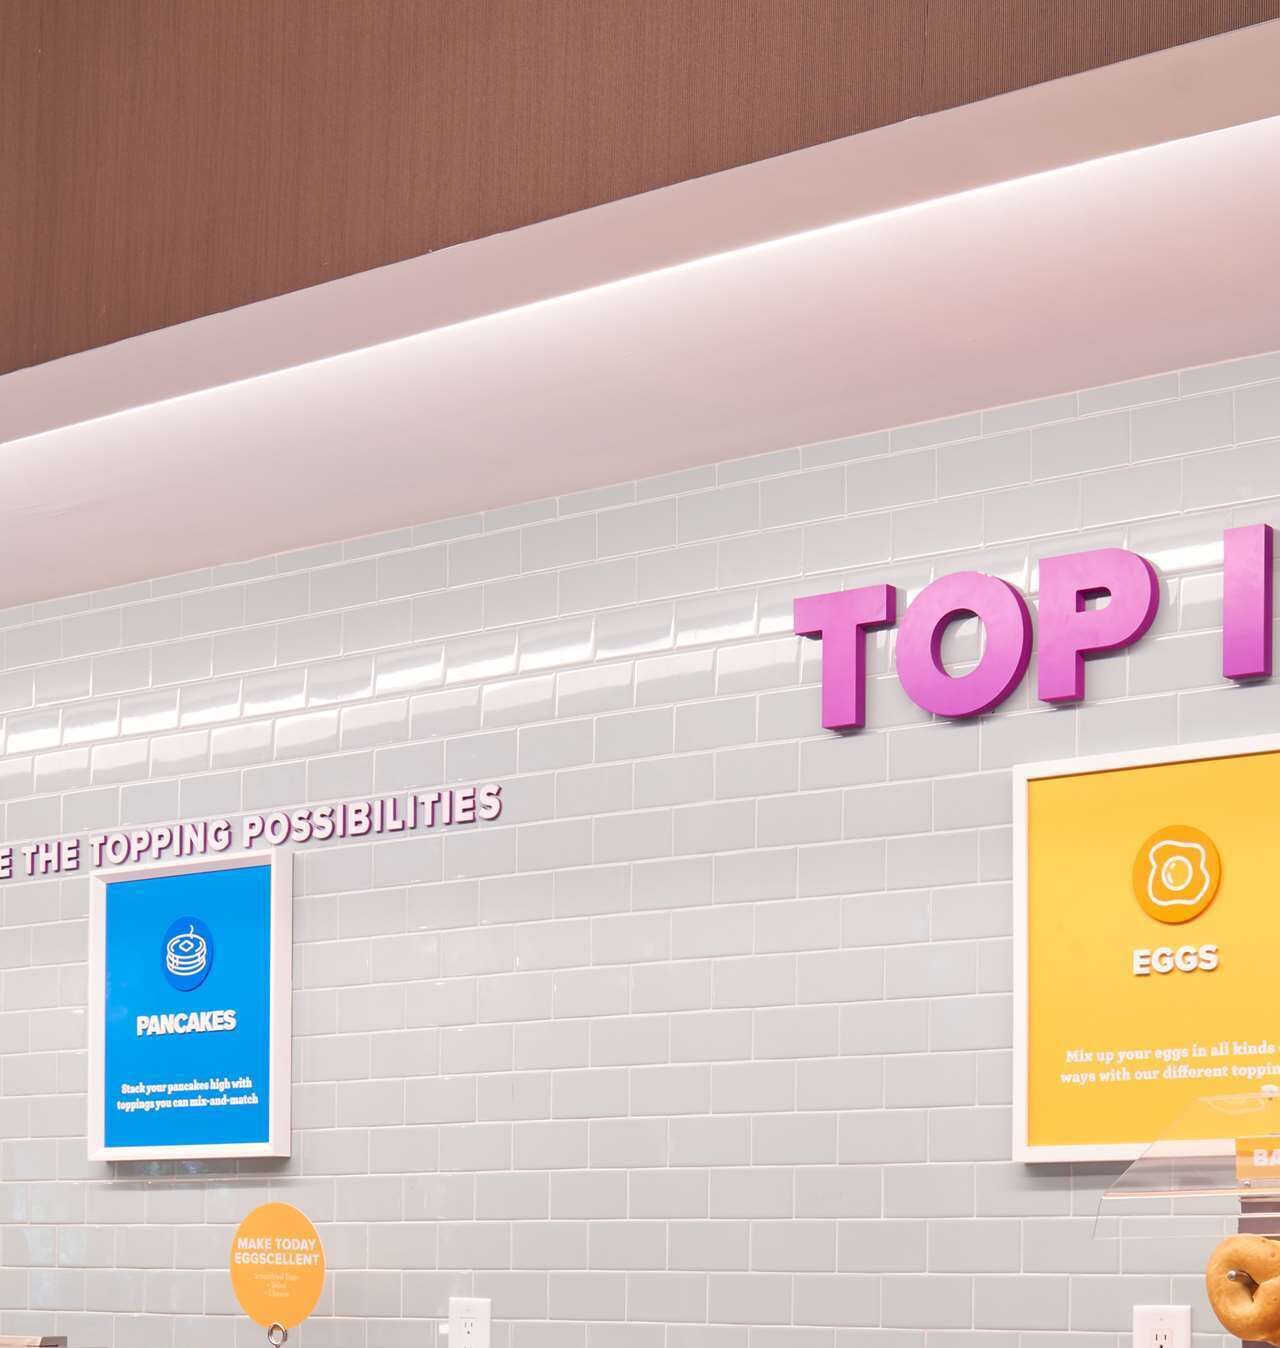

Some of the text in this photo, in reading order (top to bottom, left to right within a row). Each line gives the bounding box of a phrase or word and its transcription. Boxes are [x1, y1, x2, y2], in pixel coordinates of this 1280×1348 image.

[794, 547, 1160, 731] TOP
[21, 839, 80, 876] THE
[89, 818, 232, 867] TOPPING
[242, 784, 503, 848] POSSIBILITIES
[1131, 944, 1219, 977] EGGS
[136, 1009, 238, 1037] PANCAKES
[1065, 1050, 1094, 1063] Mix
[1096, 1051, 1114, 1064] up
[1117, 1049, 1151, 1063] your
[1154, 1047, 1189, 1061] eggs
[1192, 1043, 1207, 1058] in
[1210, 1041, 1229, 1056] all
[1233, 1040, 1275, 1055] kinds
[146, 1083, 166, 1096] your
[167, 1080, 209, 1094] pancakes
[210, 1078, 231, 1092] high
[231, 1077, 253, 1089] with
[1060, 1072, 1096, 1085] ways
[1099, 1069, 1131, 1082] with
[1134, 1069, 1159, 1081] our
[1163, 1064, 1228, 1080] different
[237, 1238, 317, 1251] MAKE TODAY
[234, 1251, 321, 1266] EGGSCELLENT
